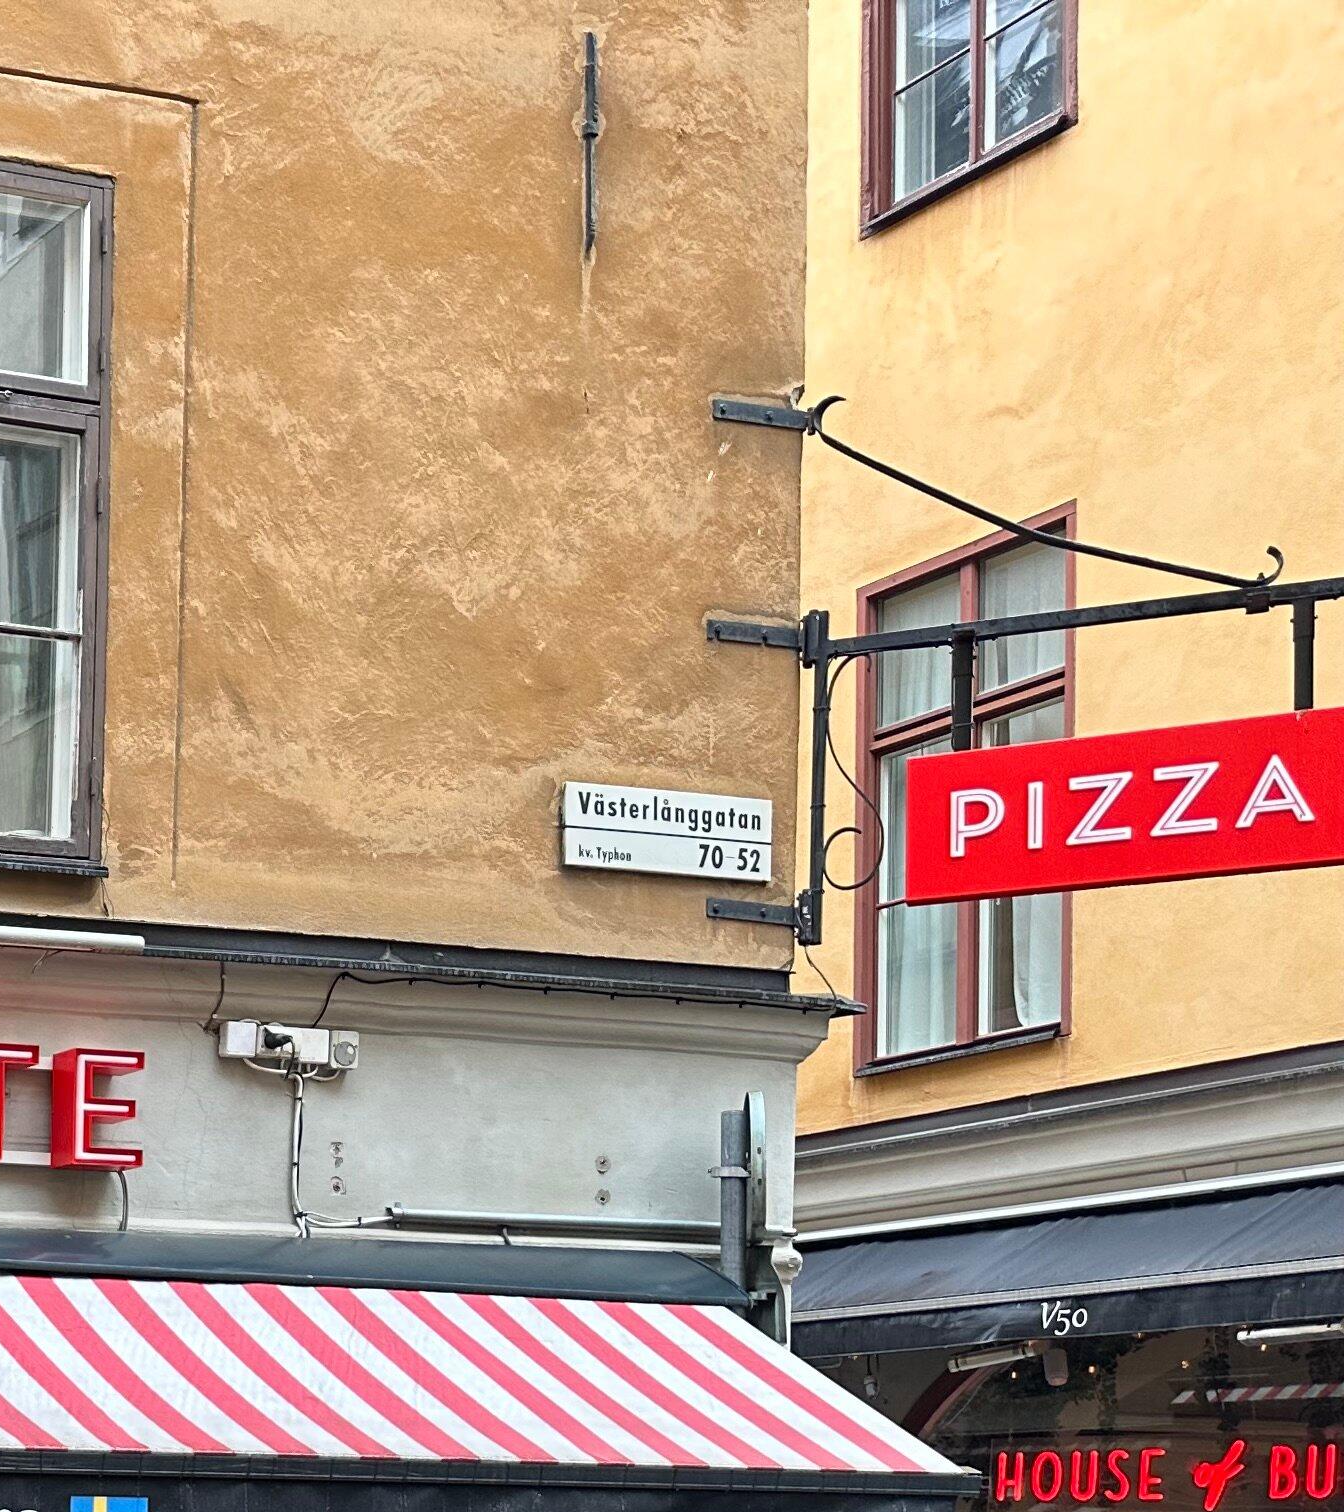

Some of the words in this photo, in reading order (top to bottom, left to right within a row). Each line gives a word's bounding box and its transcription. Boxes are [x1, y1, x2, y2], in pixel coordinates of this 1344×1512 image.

[578, 791, 761, 833] Västerlånggatan
[950, 754, 1314, 858] PIZZA
[596, 847, 632, 864] Typhon
[1040, 1301, 1088, 1337] V50
[994, 1448, 1166, 1502] HOUSE
[1193, 1440, 1247, 1512] of
